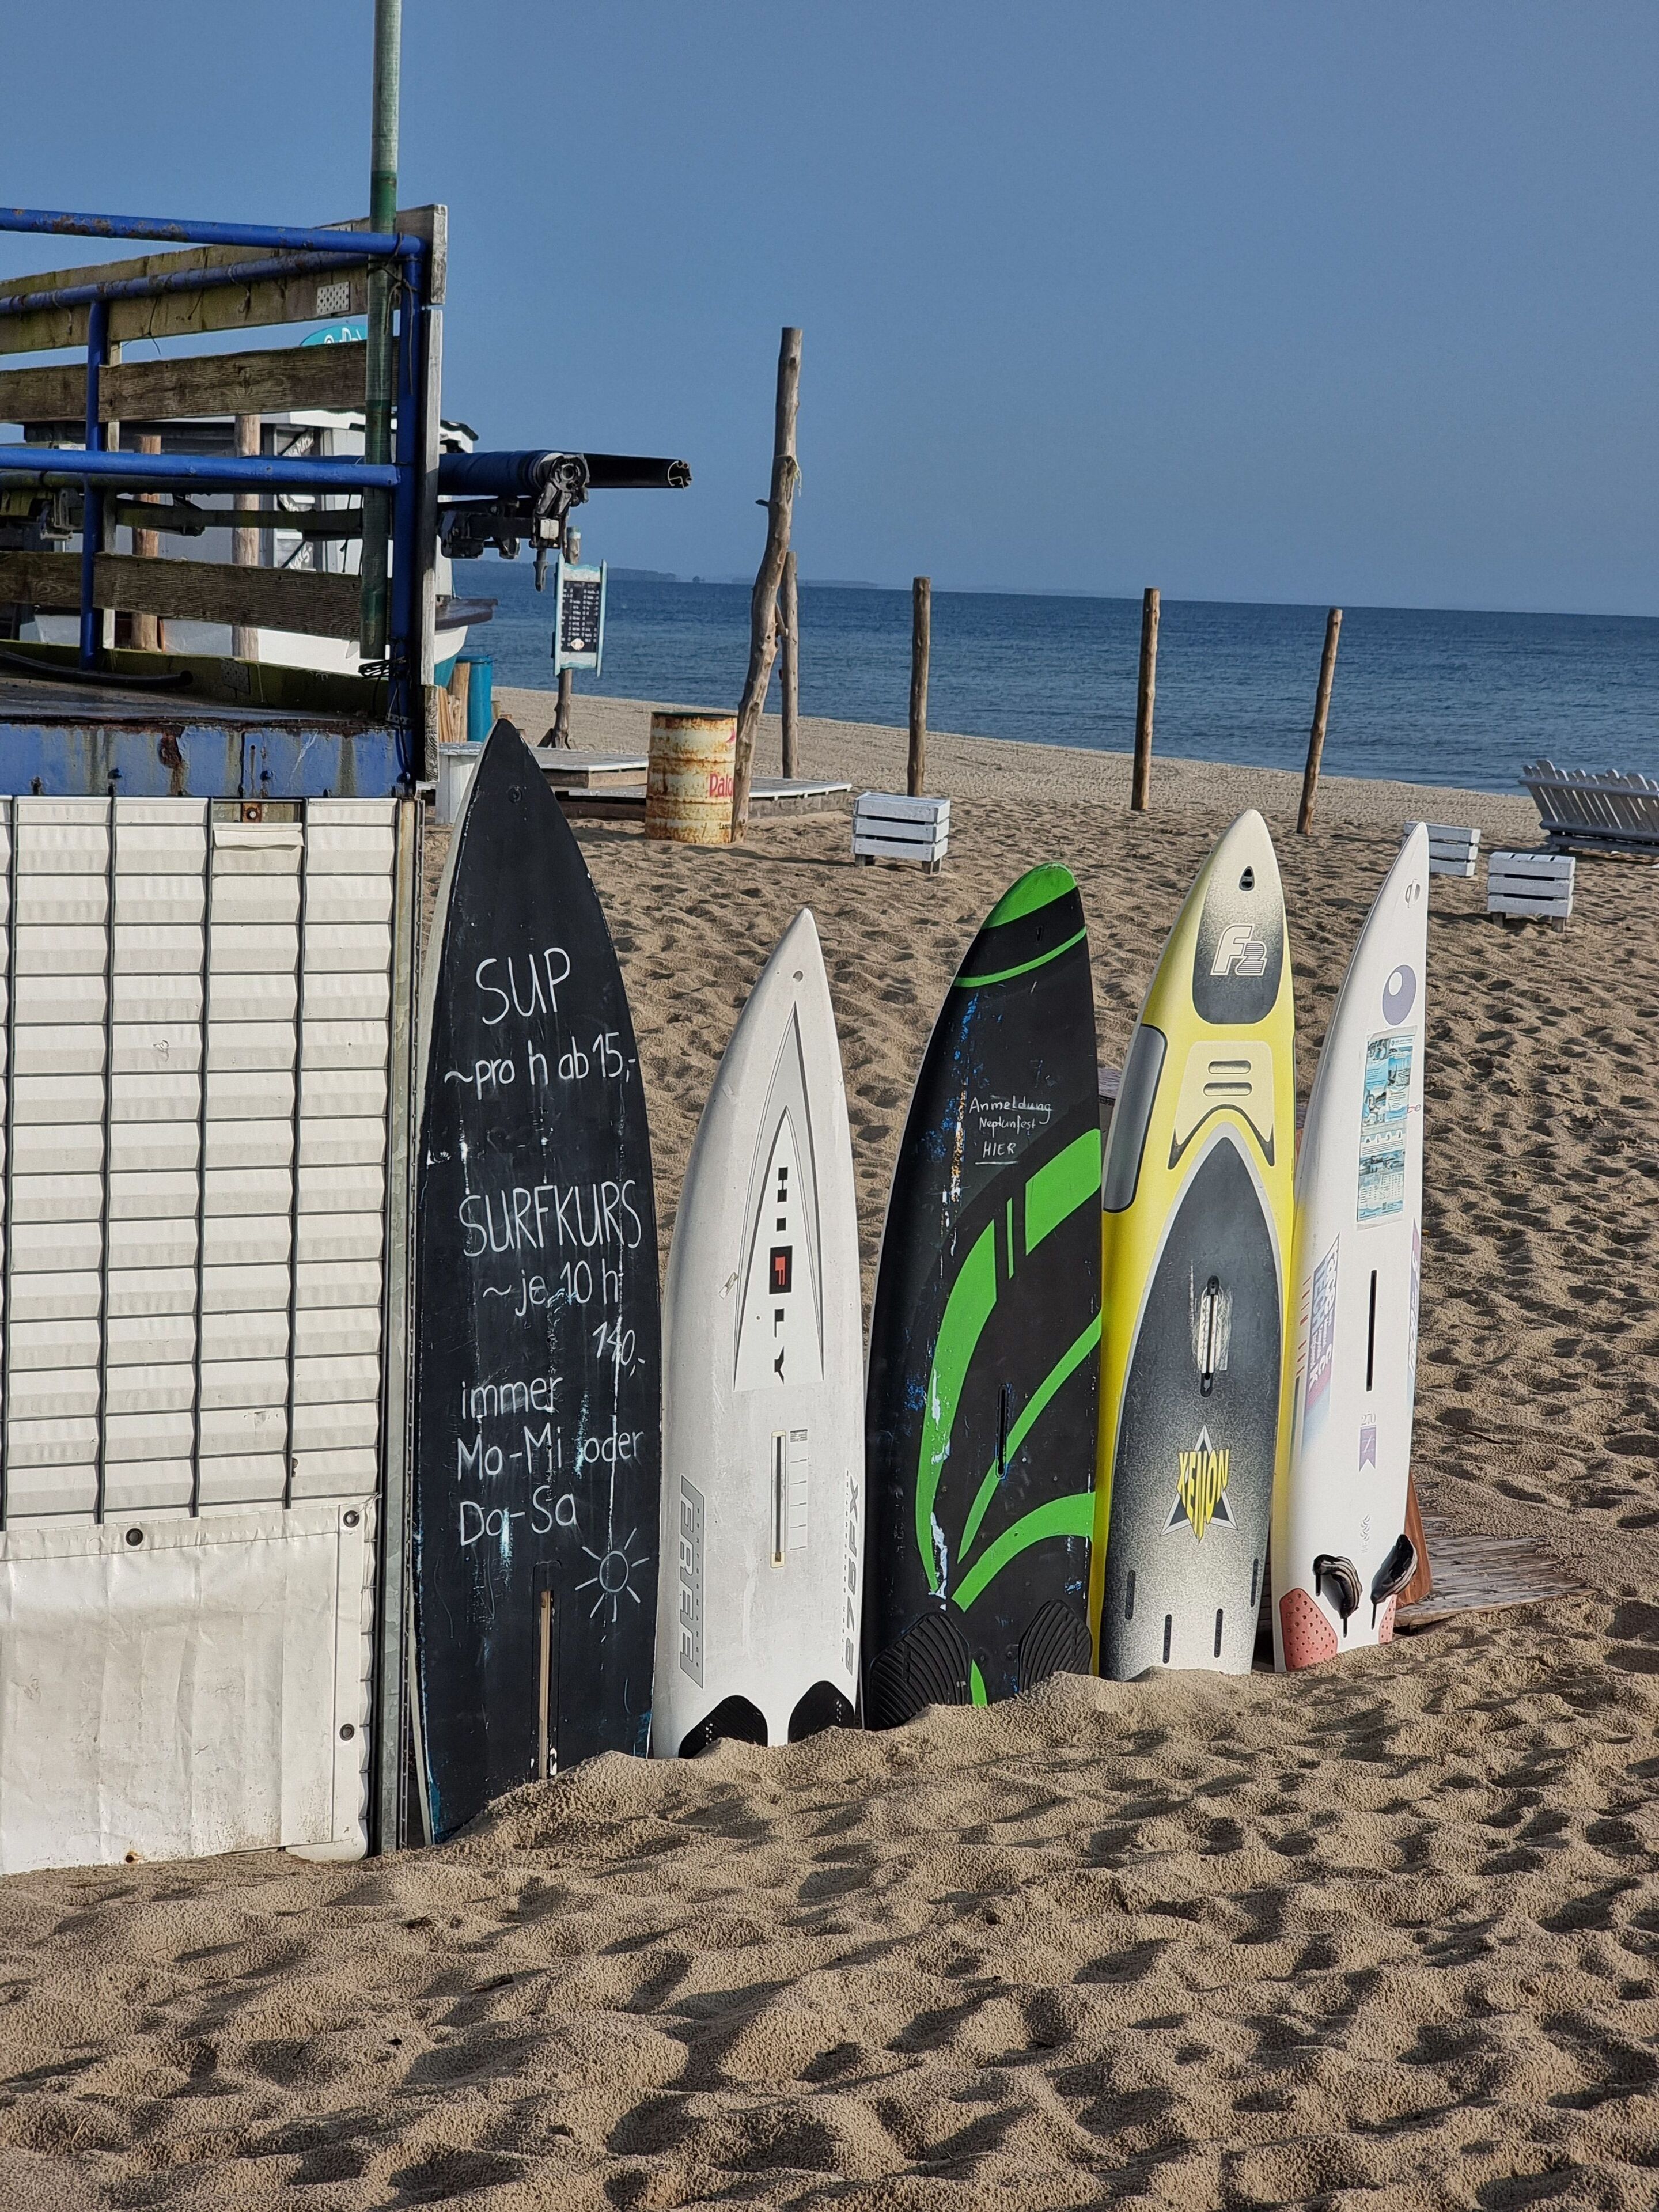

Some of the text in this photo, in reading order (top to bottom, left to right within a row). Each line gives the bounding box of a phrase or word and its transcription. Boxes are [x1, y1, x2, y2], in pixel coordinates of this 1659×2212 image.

[1210, 923, 1268, 976] F2
[475, 947, 571, 1025] SUP
[528, 1039, 549, 1085] h
[558, 1036, 590, 1081] ab
[969, 1095, 1052, 1124] Anmeldung
[979, 1115, 1036, 1138] Neptunfest
[982, 1141, 1017, 1158] HIER
[459, 1180, 643, 1257] SURFKURS
[515, 1268, 547, 1316] je
[560, 1260, 593, 1306] 10
[601, 1257, 620, 1305] h
[461, 1377, 563, 1419] immer
[457, 1422, 644, 1482] Mo-Mi oder
[1176, 1449, 1229, 1544] XENON
